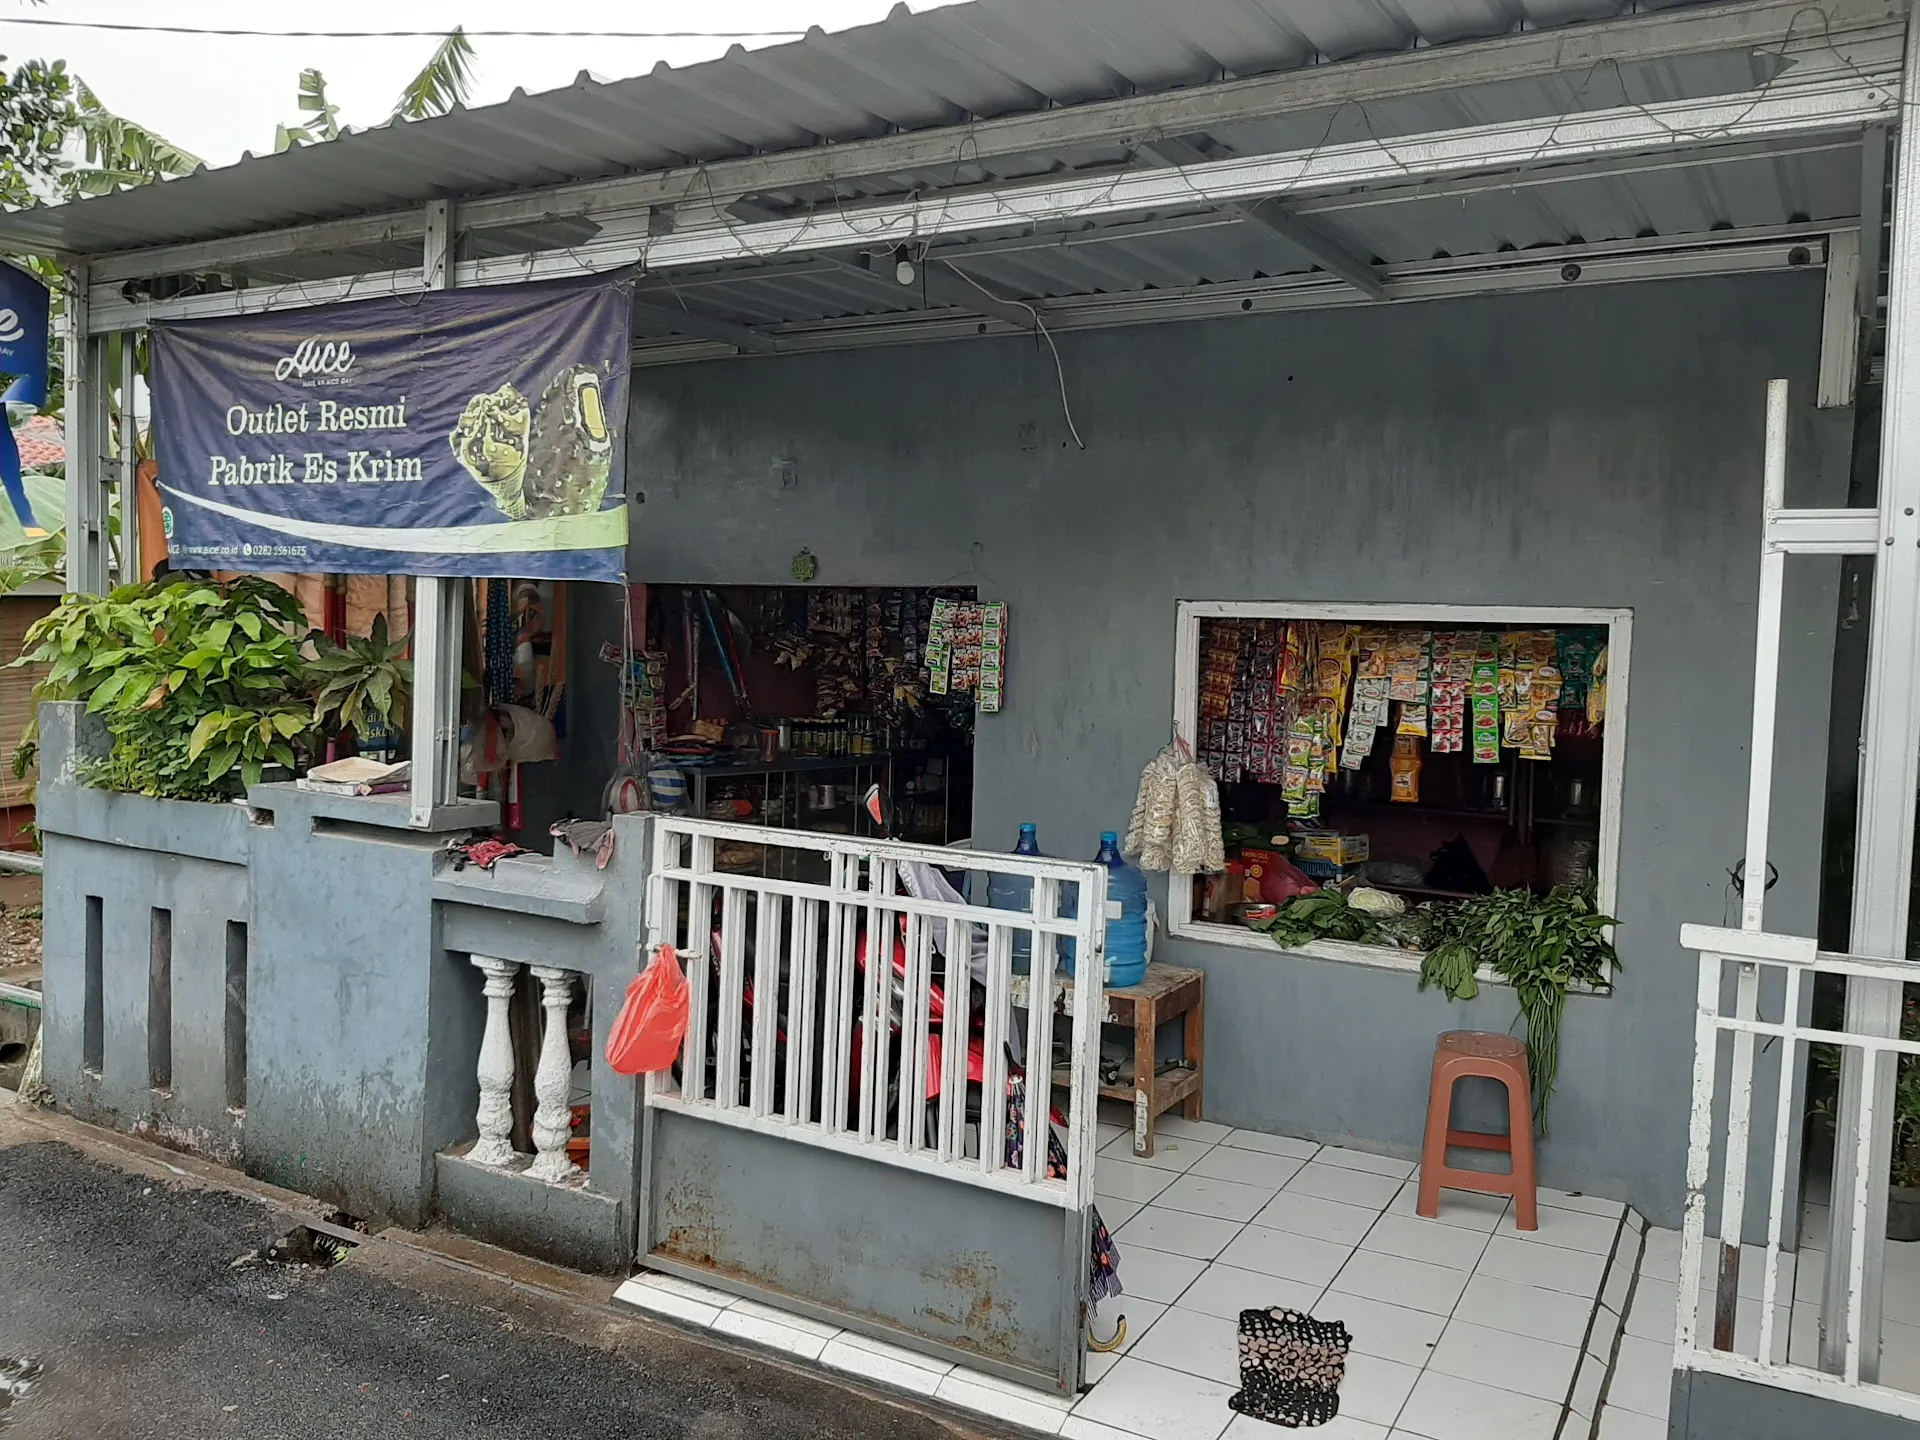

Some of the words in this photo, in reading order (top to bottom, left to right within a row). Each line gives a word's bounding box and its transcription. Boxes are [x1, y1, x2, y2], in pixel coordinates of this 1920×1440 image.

[274, 333, 356, 382] Aice
[226, 402, 310, 436] Outlet
[317, 395, 408, 432] Resmi
[207, 453, 295, 486] Pabrik
[302, 452, 338, 484] Es
[346, 450, 424, 483] Krim
[252, 545, 272, 556] 0282
